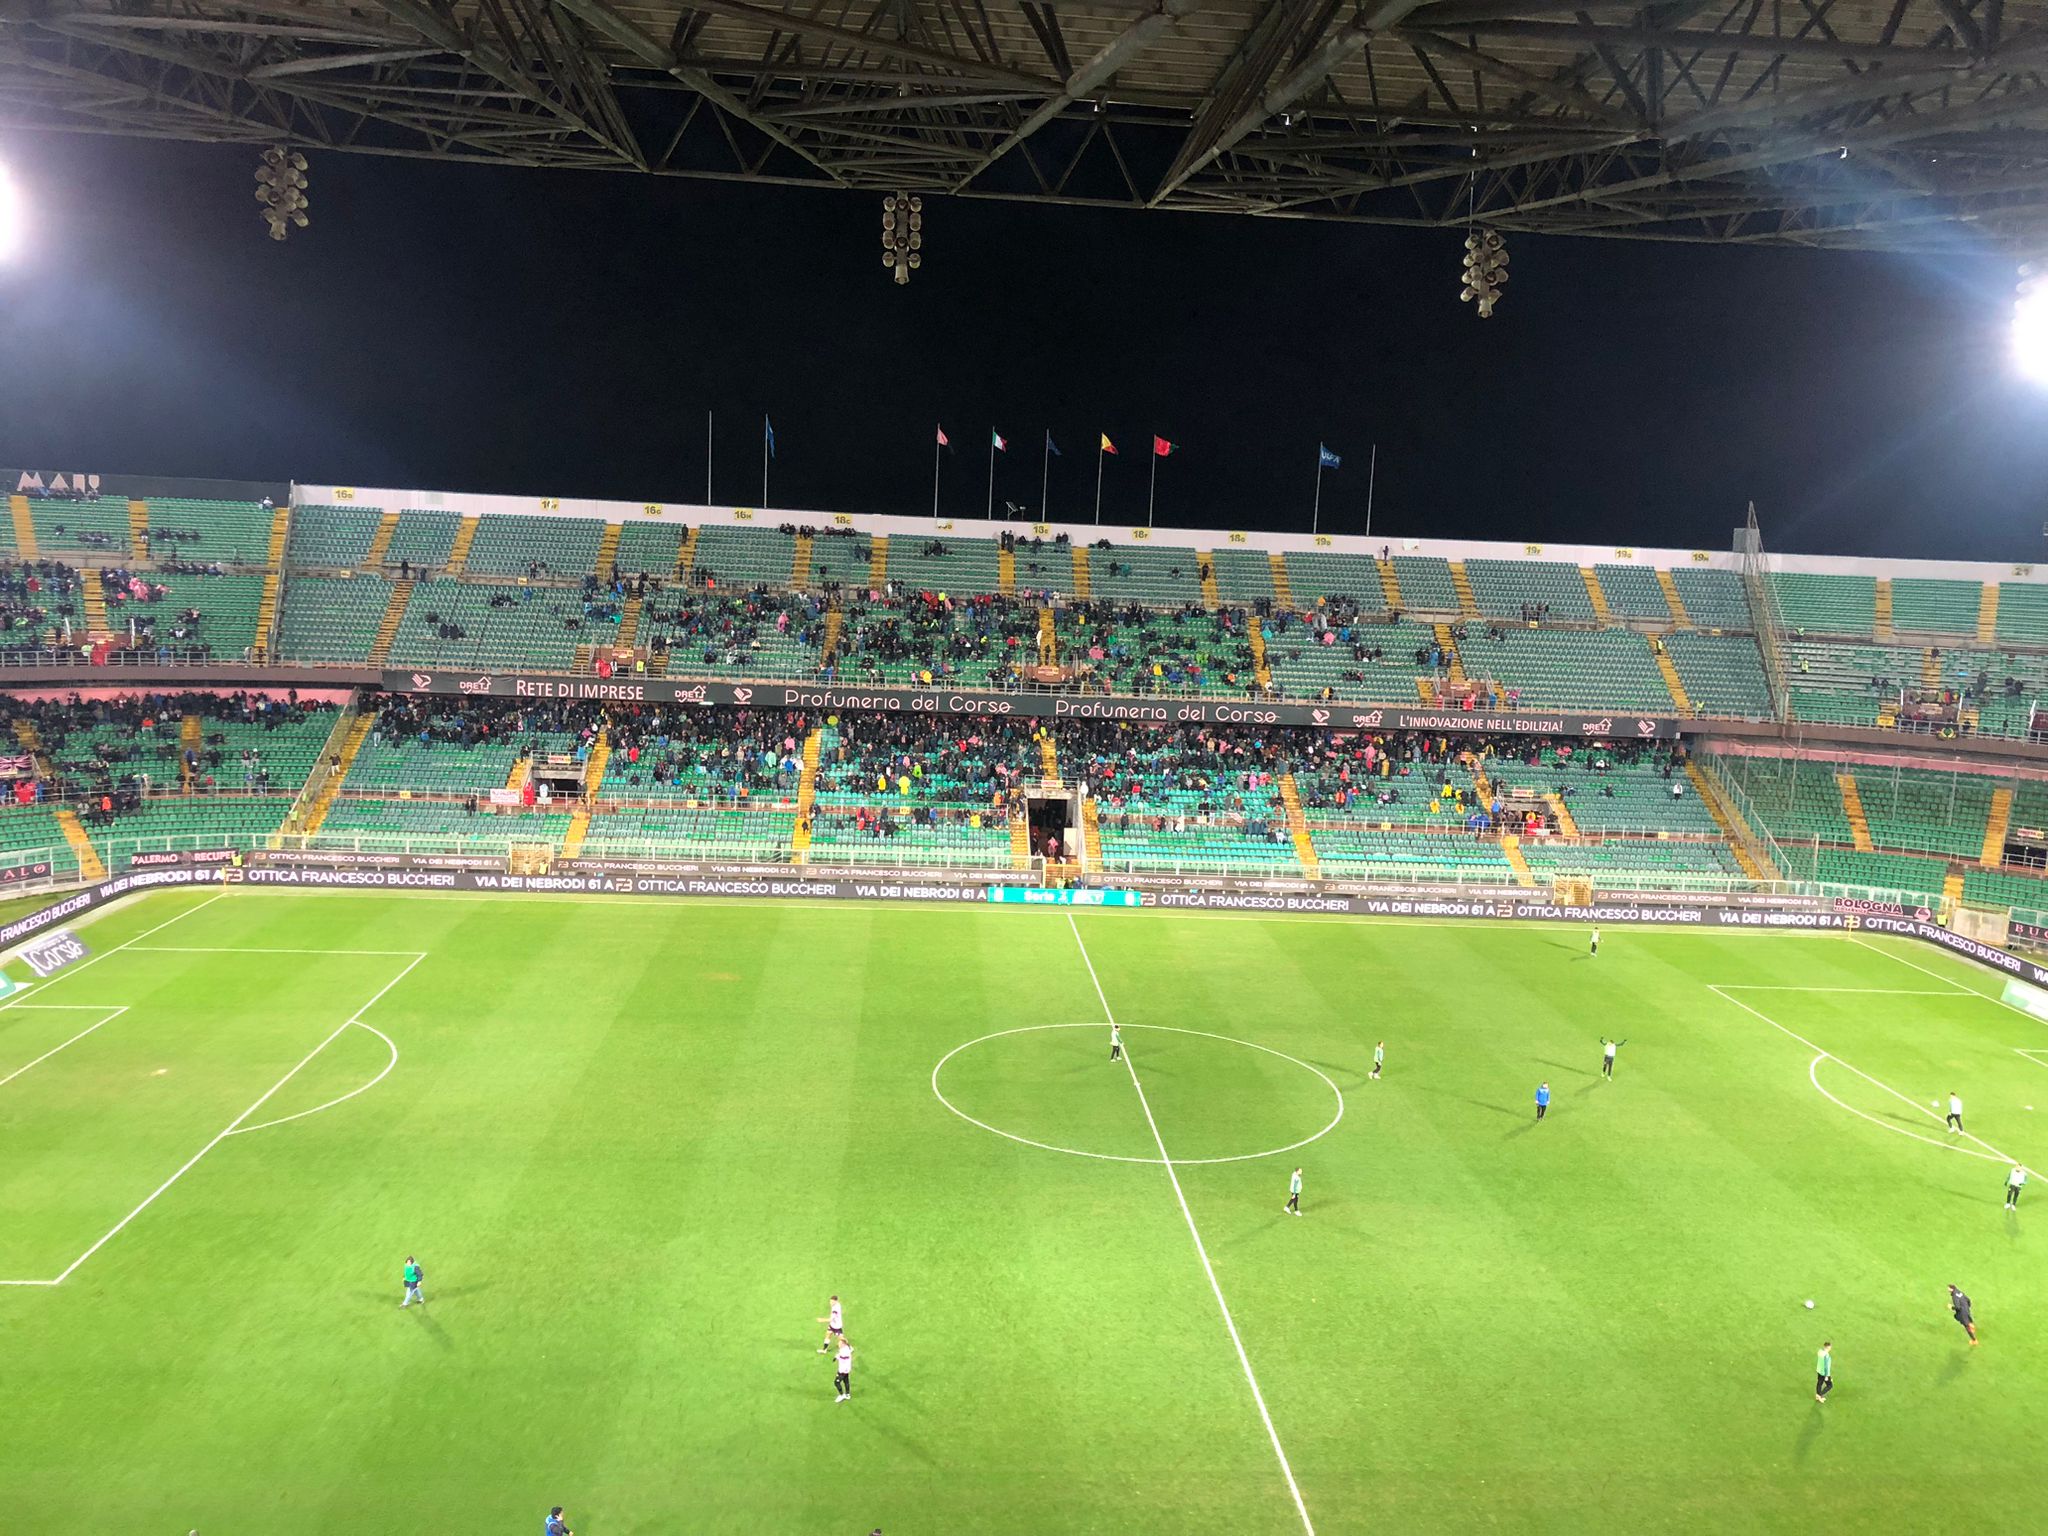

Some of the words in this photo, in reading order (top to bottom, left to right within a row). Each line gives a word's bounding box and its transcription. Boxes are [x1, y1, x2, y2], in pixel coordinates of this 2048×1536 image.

[558, 683, 574, 697] DI
[579, 684, 643, 700] IMPRESE
[785, 690, 900, 710] Profumeria
[912, 696, 939, 710] del
[950, 696, 1012, 713] Corso
[1056, 700, 1167, 720] Profumeria
[1177, 705, 1205, 720] del
[1215, 706, 1278, 724] Corso
[1400, 715, 1483, 730] L'INNOVAZIONE
[1487, 718, 1563, 732] NELL'EDILIZIA!
[132, 854, 178, 865] PALERMO
[302, 854, 354, 862] FRANCESCO
[100, 884, 113, 898] VIA
[114, 878, 128, 892] DEI
[130, 870, 192, 887] NEBRODI
[212, 870, 224, 880] A
[249, 871, 298, 882] OTTICA
[301, 872, 384, 884] FRANCESCO
[388, 873, 454, 885] BUCCHERI
[475, 876, 498, 887] VIA
[502, 878, 522, 888] DEI
[526, 878, 585, 889] NEBRODI
[588, 879, 601, 889] 61
[604, 879, 614, 890] A
[638, 880, 686, 891] OTTICA
[689, 881, 768, 894] FRANCESCO
[771, 883, 835, 895] BUCCHERI
[855, 885, 878, 896] VIA
[880, 886, 900, 897] DEI
[904, 887, 960, 899] NEBRODI
[963, 888, 974, 899] 61
[977, 890, 986, 899] A
[1161, 895, 1206, 906] OTTICA
[1209, 896, 1284, 908] FRANCESCO
[1287, 899, 1349, 911] BUCCHERI
[1368, 902, 1389, 912] VIA
[1392, 902, 1411, 912] DEI
[1414, 903, 1469, 914] NEBRODI
[1471, 904, 1484, 915] 61
[1485, 905, 1496, 915] A
[1835, 898, 1902, 914] BOLOGNA
[0, 910, 50, 942] FRANCESCO
[52, 893, 90, 919] BUCCHERI
[1518, 906, 1562, 917] OTTICA
[1565, 908, 1638, 920] FRANCESCO
[1642, 910, 1700, 921] BUCCHERI
[1719, 912, 1739, 922] VIA
[1741, 913, 1761, 923] DEI
[1764, 913, 1816, 925] NEBRODI
[1819, 916, 1831, 925] 61
[1833, 917, 1842, 926] A
[1866, 917, 1916, 934] OTTICA
[1919, 926, 1976, 953] FRANCESCO
[1977, 944, 2020, 971] BUCCHERI
